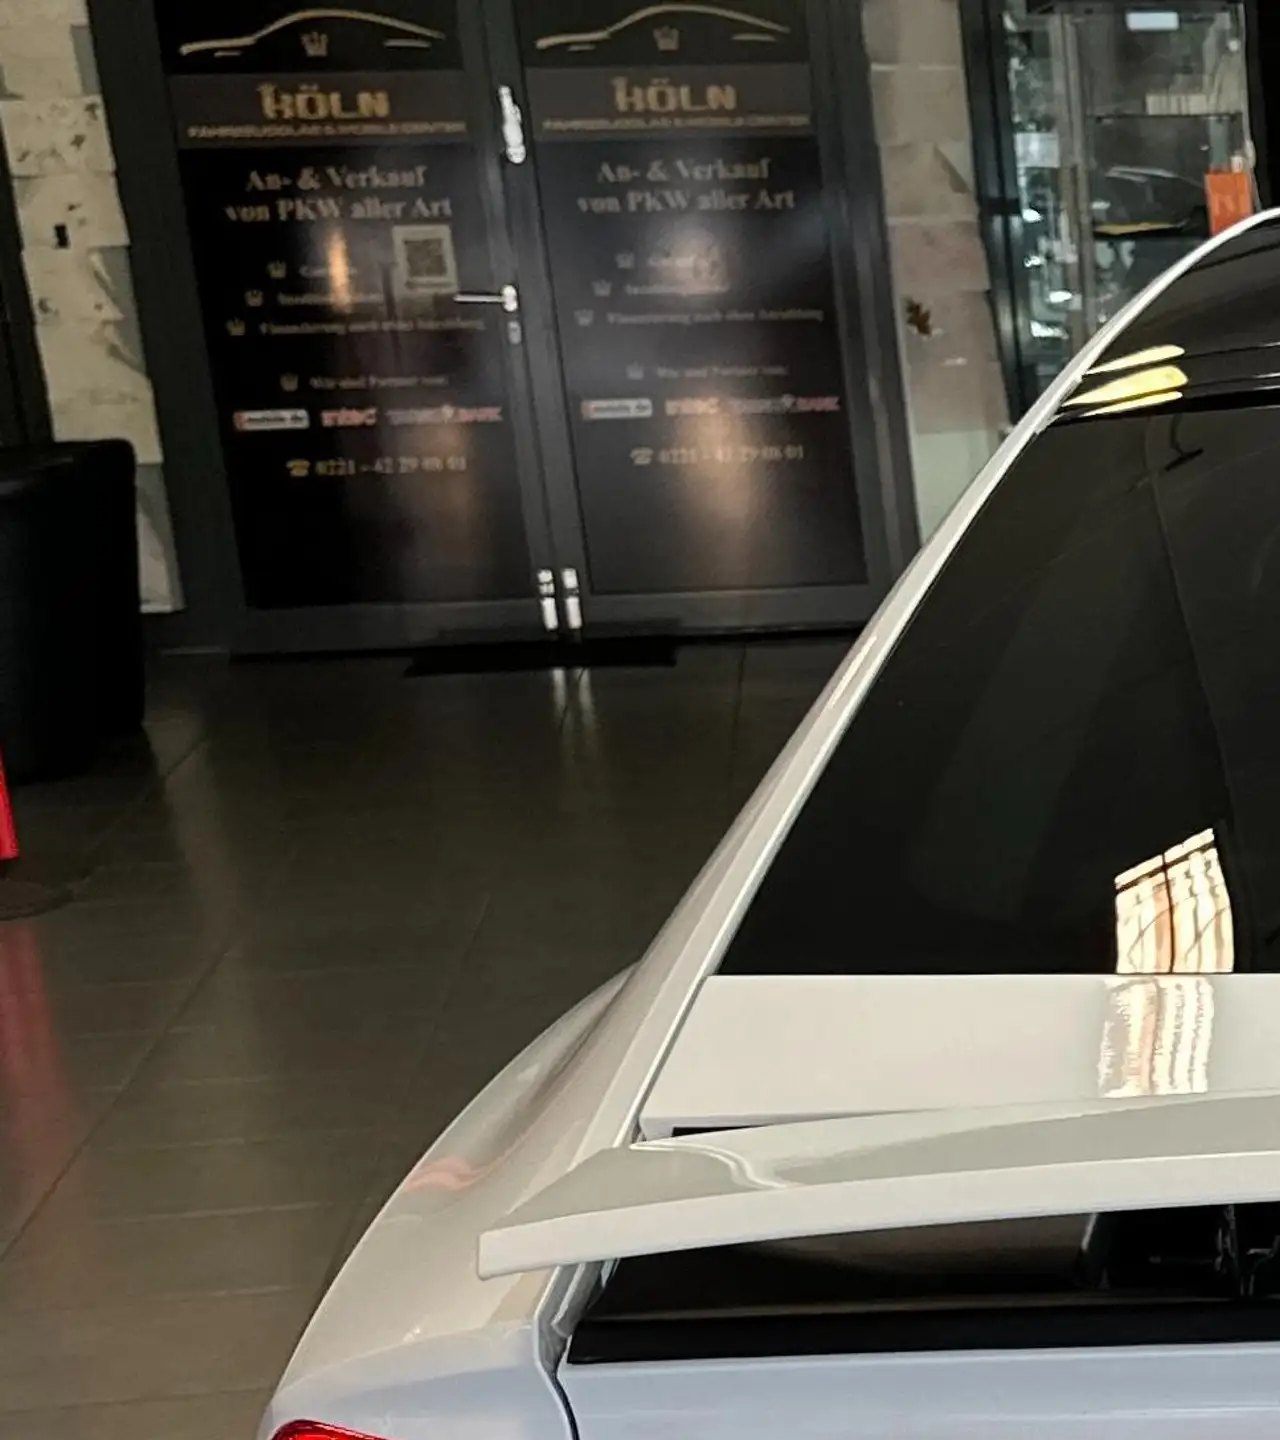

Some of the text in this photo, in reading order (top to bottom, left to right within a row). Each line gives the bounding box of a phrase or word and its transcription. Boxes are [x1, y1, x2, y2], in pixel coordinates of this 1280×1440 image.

[245, 164, 427, 192] An- & Verkauf
[598, 157, 771, 183] An- & Verkauf
[224, 196, 452, 222] von PKW aller Art
[577, 188, 795, 213] von PKW aller Art
